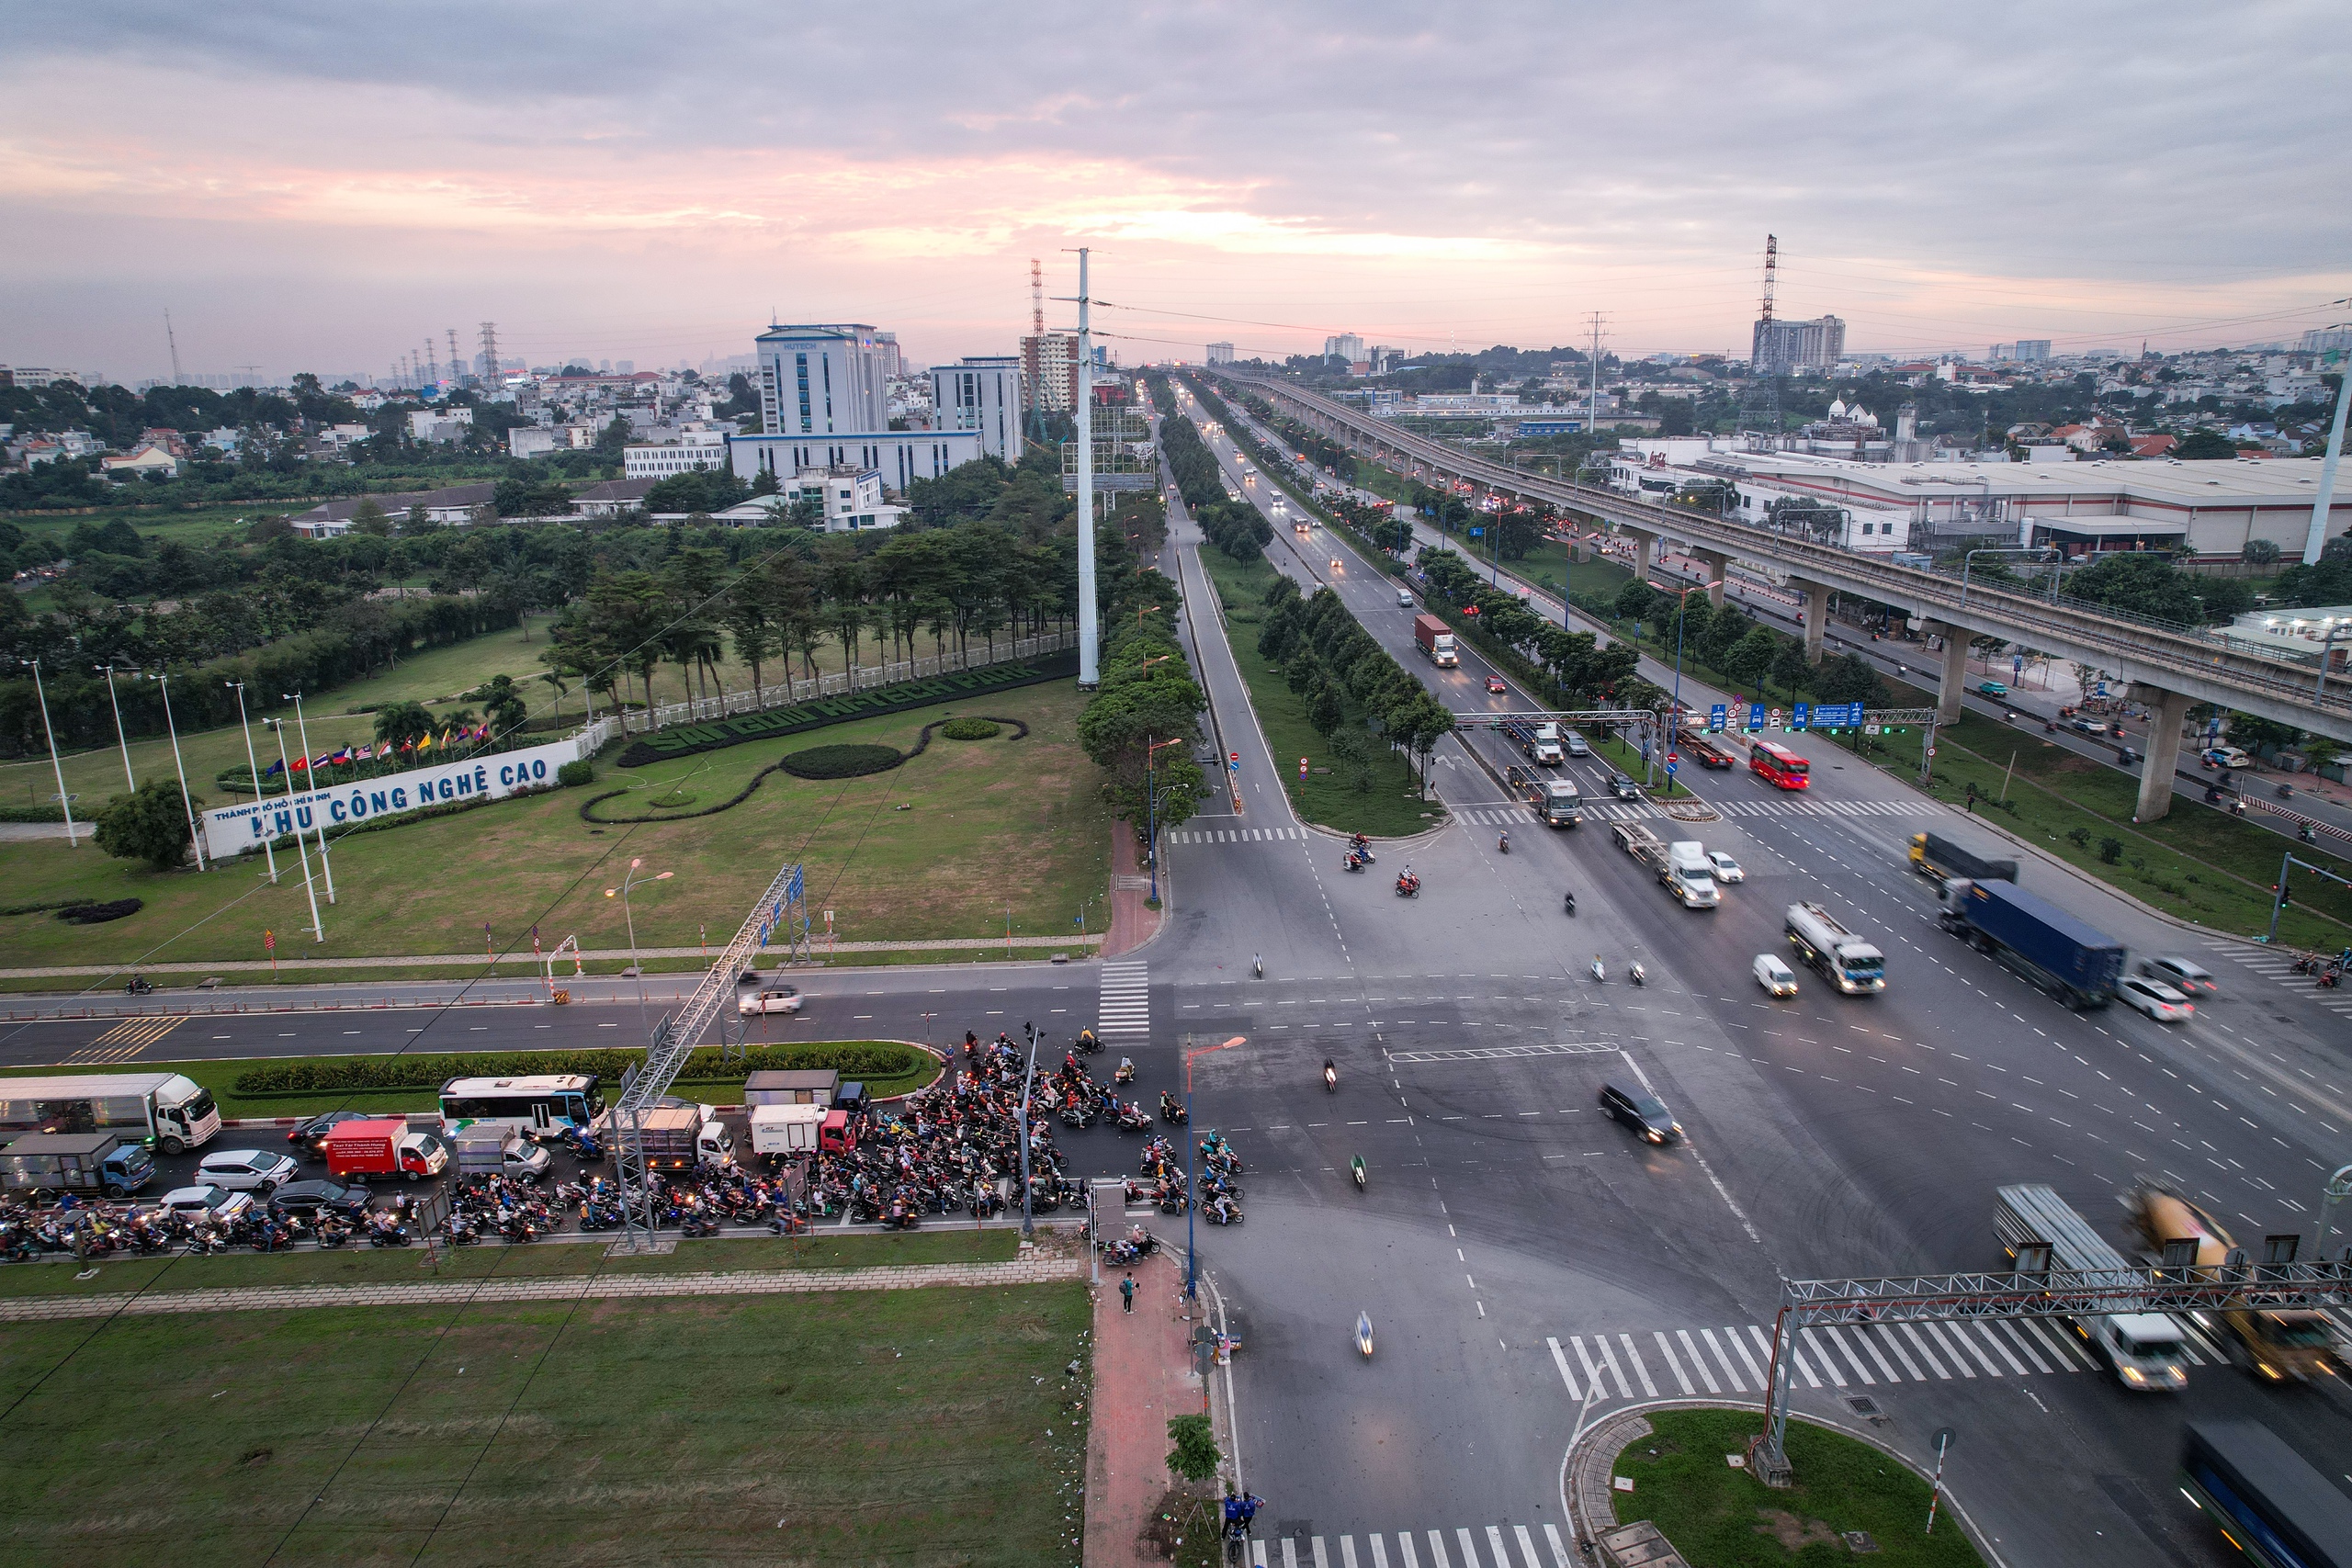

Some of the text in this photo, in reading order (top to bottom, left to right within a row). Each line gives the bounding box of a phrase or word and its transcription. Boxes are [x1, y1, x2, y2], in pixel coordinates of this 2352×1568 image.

[643, 722, 729, 751] SAI
[953, 663, 1041, 689] PARK
[214, 808, 252, 820] THÀNH
[275, 798, 288, 809] HỒ
[331, 787, 408, 821] CÔNG
[500, 760, 546, 786] CAO
